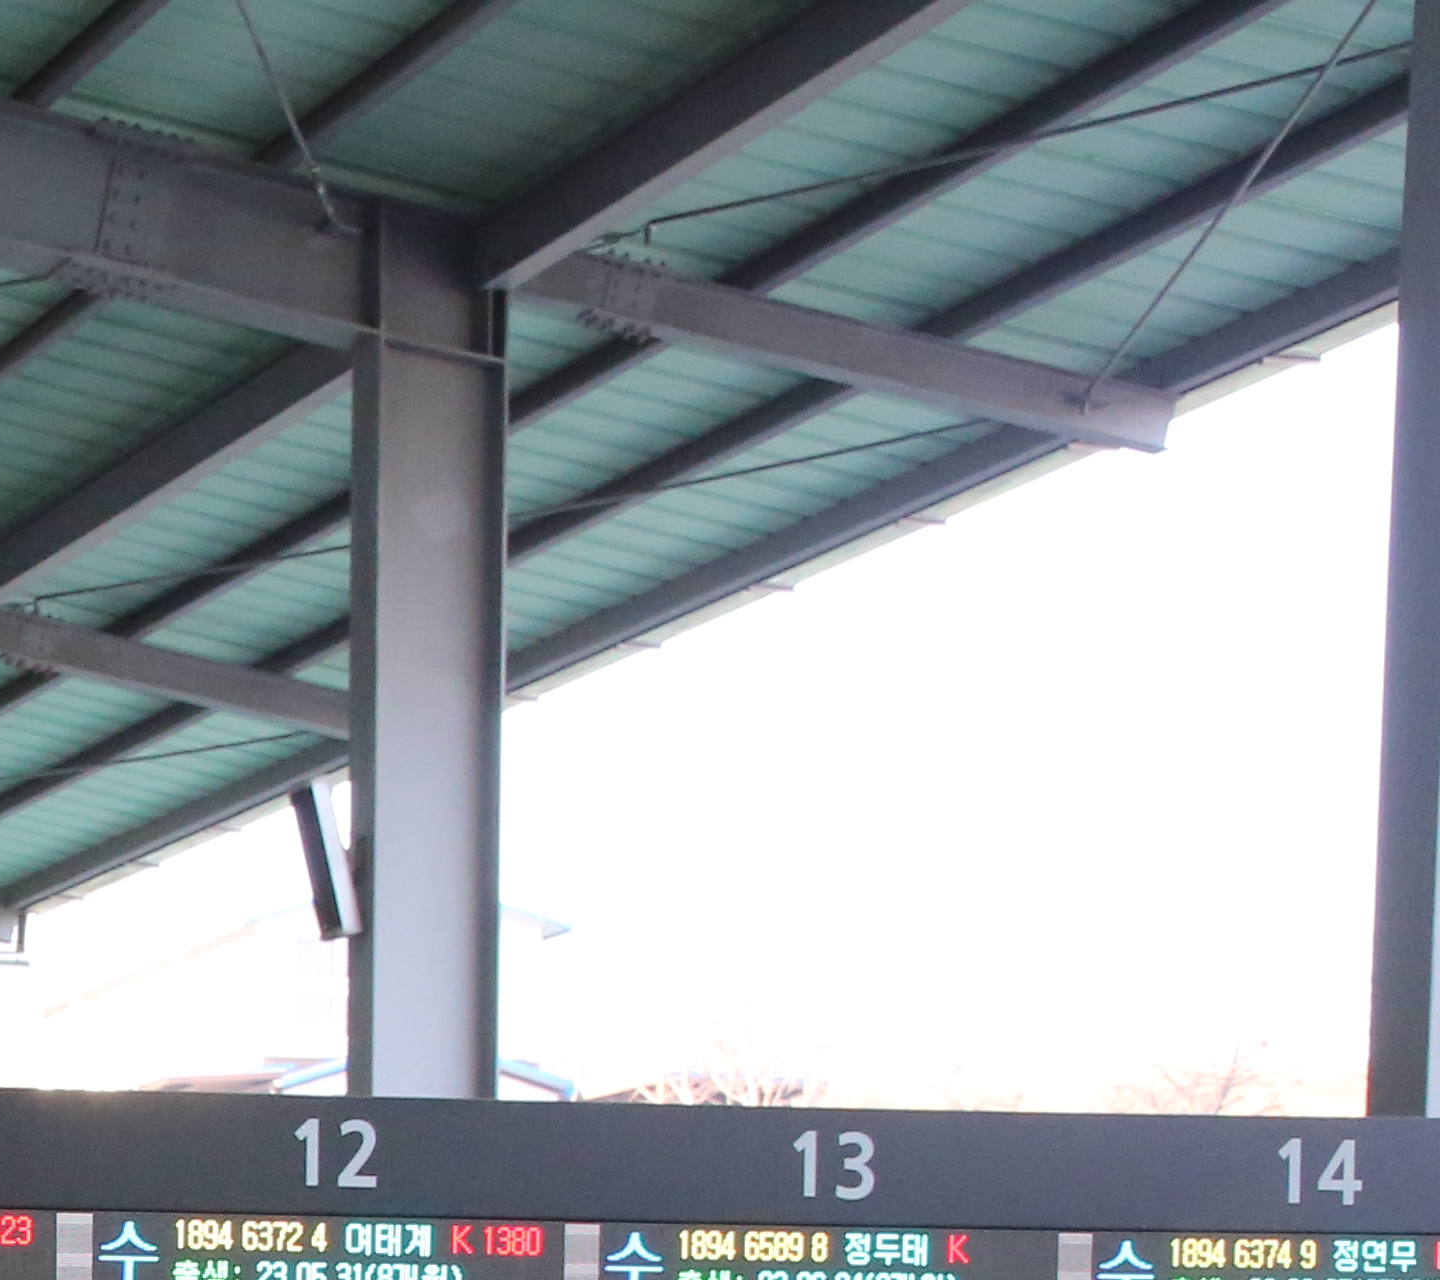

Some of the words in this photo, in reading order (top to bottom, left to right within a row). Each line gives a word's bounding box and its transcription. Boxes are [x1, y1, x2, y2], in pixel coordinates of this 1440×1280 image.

[294, 1118, 378, 1188] 12
[793, 1130, 875, 1200] 13
[1278, 1138, 1363, 1206] 14
[175, 1218, 235, 1251] 1894
[241, 1220, 304, 1252] 6372
[311, 1222, 328, 1253] 4
[451, 1224, 475, 1255] K
[483, 1224, 545, 1257] 1380
[679, 1229, 738, 1261] 1894
[744, 1230, 805, 1262] 6589
[811, 1231, 829, 1263] 8
[844, 1232, 929, 1267] 정두태
[946, 1234, 971, 1264] K
[1170, 1237, 1227, 1268] 1894
[1233, 1238, 1293, 1269] 6374
[1299, 1239, 1317, 1269] 9
[1332, 1239, 1417, 1273] 정연무
